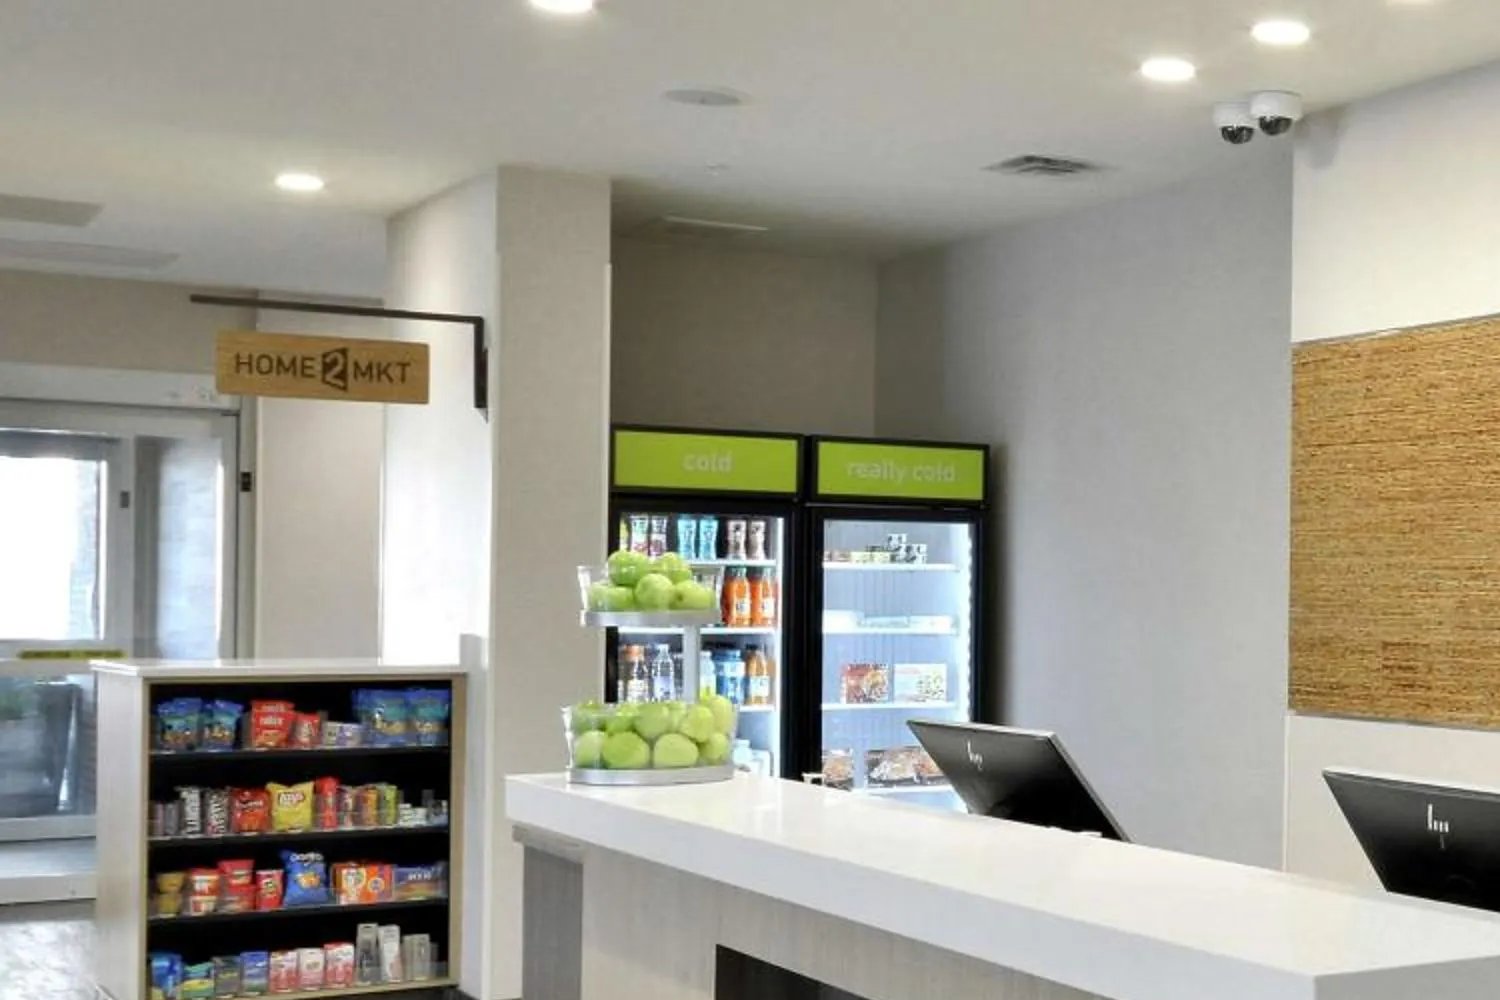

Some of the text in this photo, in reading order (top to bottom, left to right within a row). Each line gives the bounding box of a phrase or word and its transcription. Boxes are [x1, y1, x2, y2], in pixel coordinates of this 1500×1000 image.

[352, 361, 412, 384] MKT
[682, 450, 732, 473] cold
[846, 459, 956, 485] really cold
